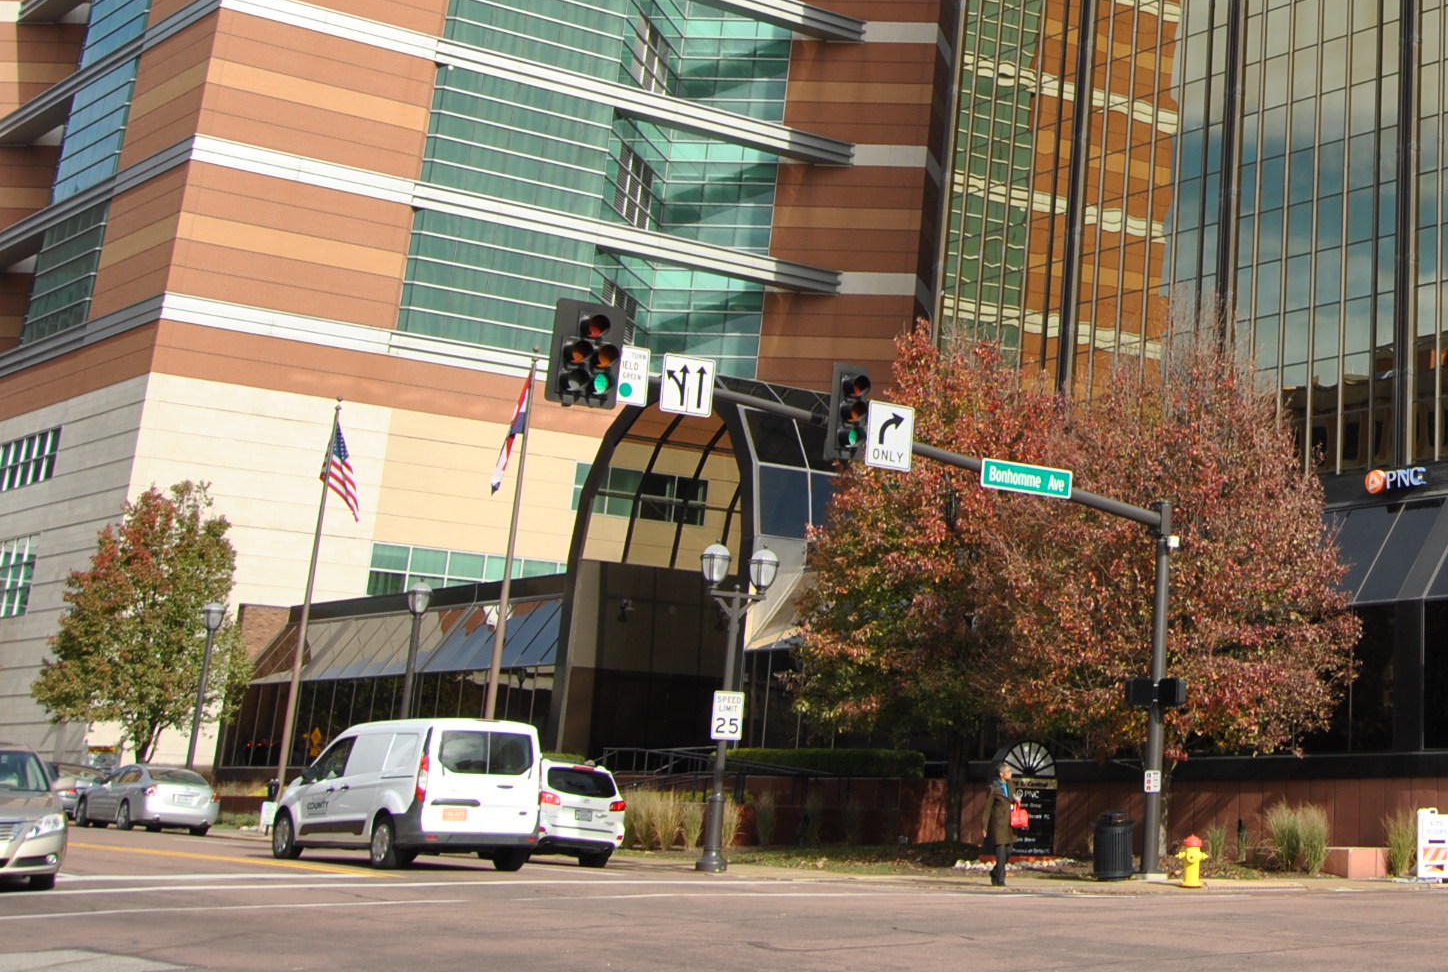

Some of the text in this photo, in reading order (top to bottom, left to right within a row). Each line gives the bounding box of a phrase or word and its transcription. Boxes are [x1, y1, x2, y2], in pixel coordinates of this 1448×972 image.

[632, 352, 646, 361] TURN
[622, 361, 639, 371] IELD
[622, 372, 641, 381] GREEN
[872, 448, 904, 463] ONLY
[989, 466, 1065, 492] Bonhomme Ave
[1386, 466, 1424, 489] PNC
[717, 695, 742, 704] SPEED
[719, 705, 738, 713] LIMIT
[715, 717, 739, 734] 25
[1024, 790, 1040, 799] PNC
[306, 800, 329, 810] COUNTY
